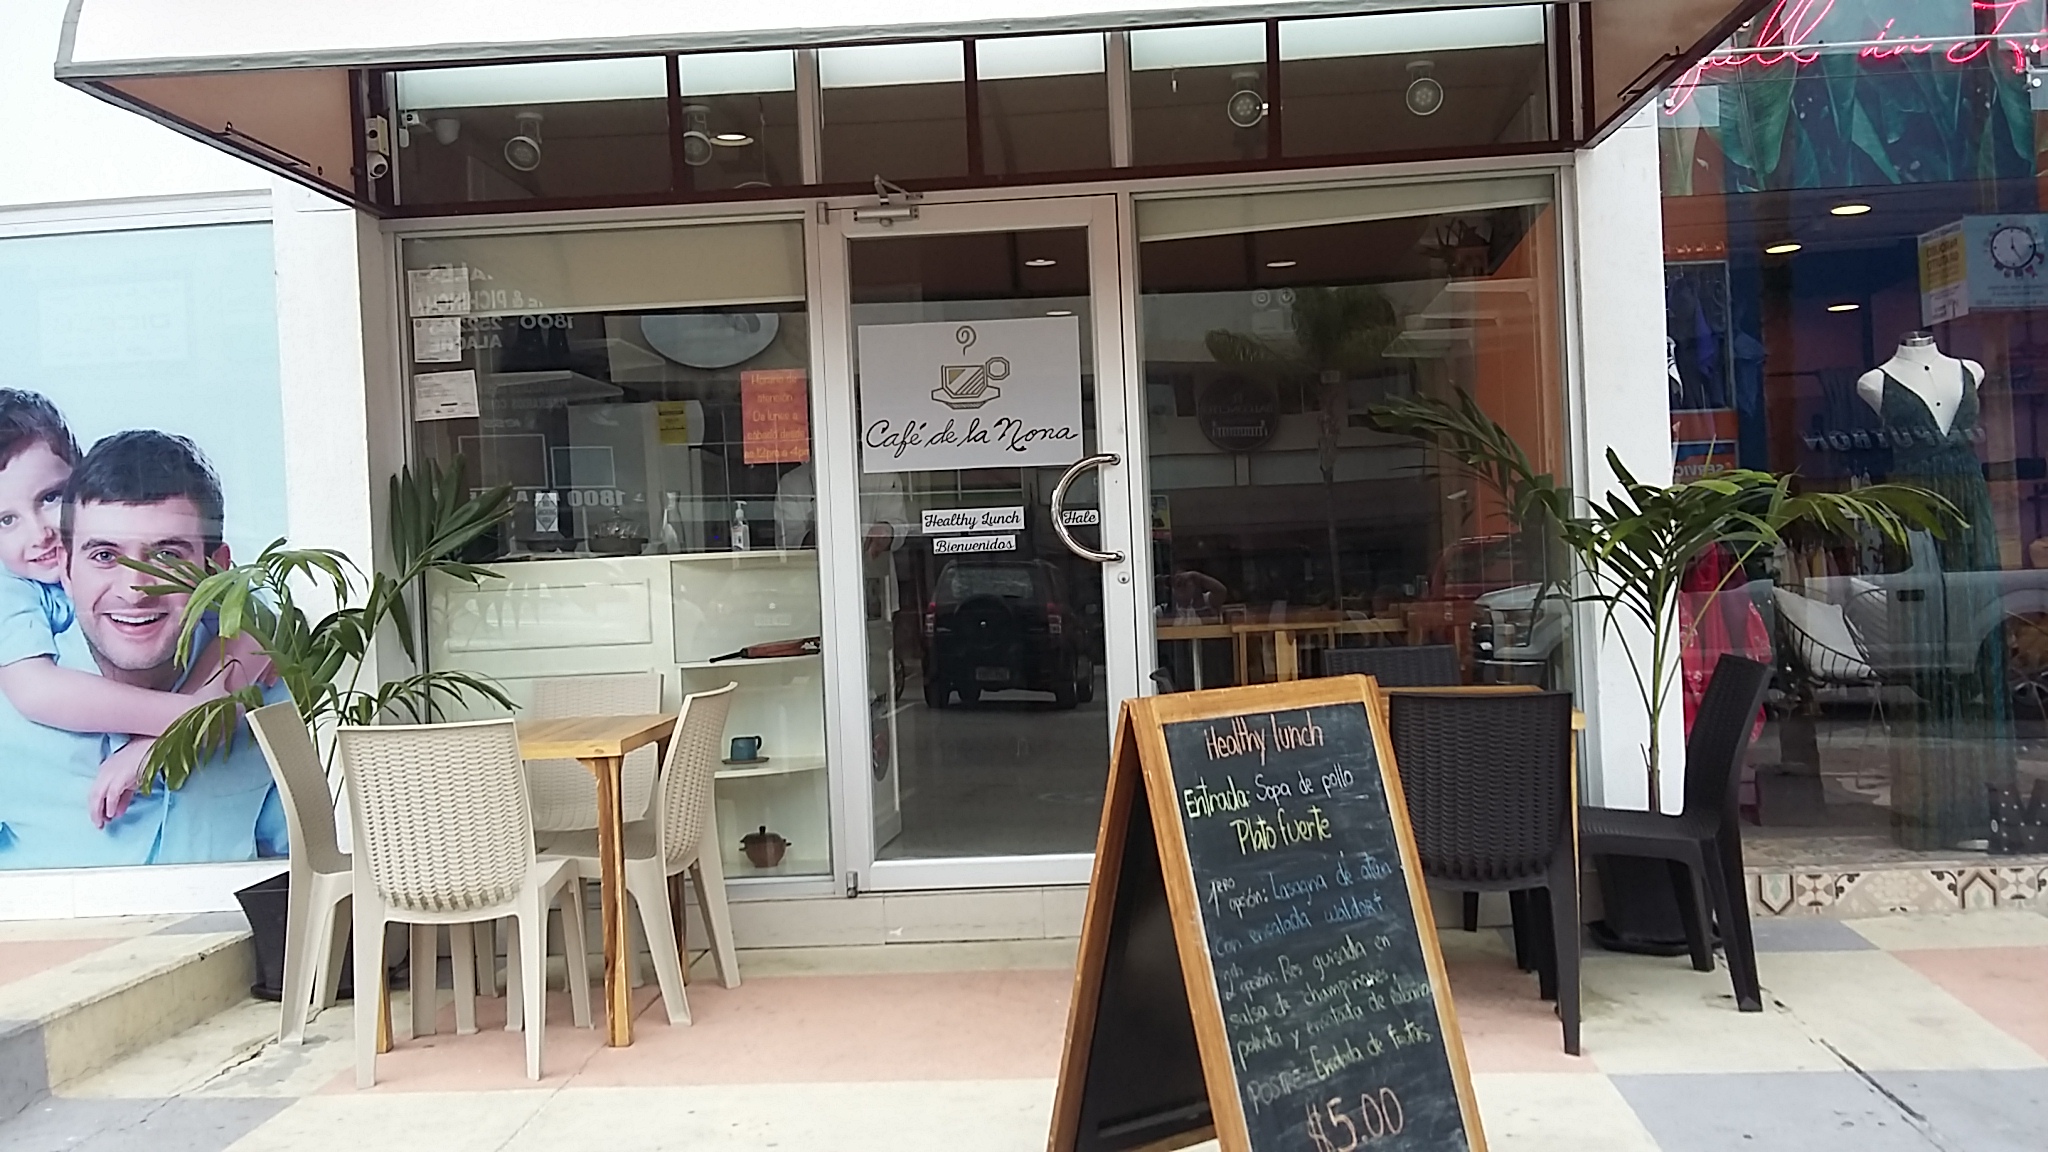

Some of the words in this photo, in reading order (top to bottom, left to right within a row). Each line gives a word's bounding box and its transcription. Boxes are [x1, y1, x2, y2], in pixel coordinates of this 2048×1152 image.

[866, 419, 927, 458] Café
[924, 418, 960, 449] de
[957, 417, 991, 448] la
[993, 416, 1078, 453] Nona
[923, 512, 977, 531] Healthy
[980, 510, 1021, 528] Lunch
[1063, 510, 1097, 525] Hale
[935, 537, 1015, 553] Bienvenidos
[1204, 717, 1266, 766] Healthy
[1272, 711, 1324, 753] lunch
[1183, 775, 1252, 819] Entrada:
[1255, 774, 1291, 806] Sopa
[1298, 770, 1313, 794] de
[1321, 763, 1354, 798] pollo
[1230, 814, 1277, 855] Plato
[1277, 806, 1332, 846] fuerte
[1269, 872, 1328, 906] Lasagna
[1336, 852, 1353, 887] de
[1249, 905, 1312, 942] ensalada
[1278, 954, 1303, 984] Res
[1313, 934, 1367, 982] guisada
[1374, 934, 1391, 952] en
[1229, 1002, 1268, 1029] salsa
[1274, 992, 1292, 1015] de
[1290, 1029, 1300, 1051] y
[1368, 992, 1387, 1012] de
[1367, 1031, 1385, 1057] de
[1306, 1086, 1404, 1152] $5.00
